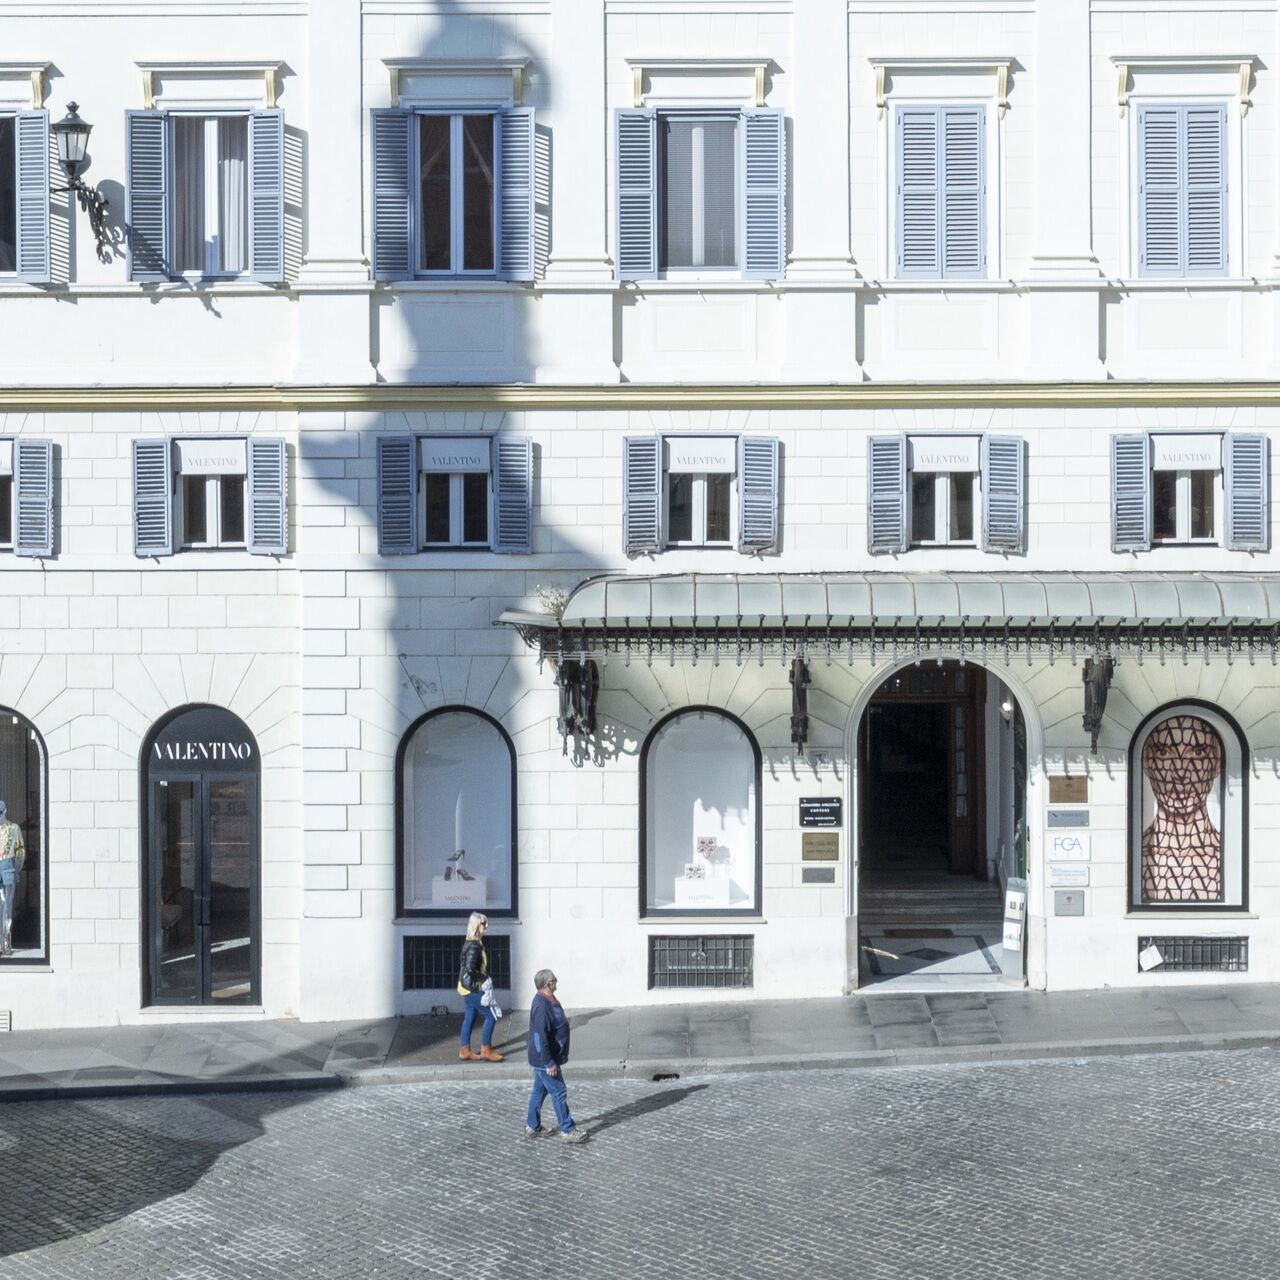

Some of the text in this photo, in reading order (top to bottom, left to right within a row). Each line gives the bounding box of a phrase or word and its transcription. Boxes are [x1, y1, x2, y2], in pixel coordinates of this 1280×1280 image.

[188, 457, 237, 467] VALENTINO
[432, 456, 481, 465] VALENTINO
[676, 456, 726, 465] VALENTINO
[920, 455, 969, 464] VALENTINO
[1162, 453, 1211, 463] VALENTINO
[154, 742, 251, 760] VALENTINO
